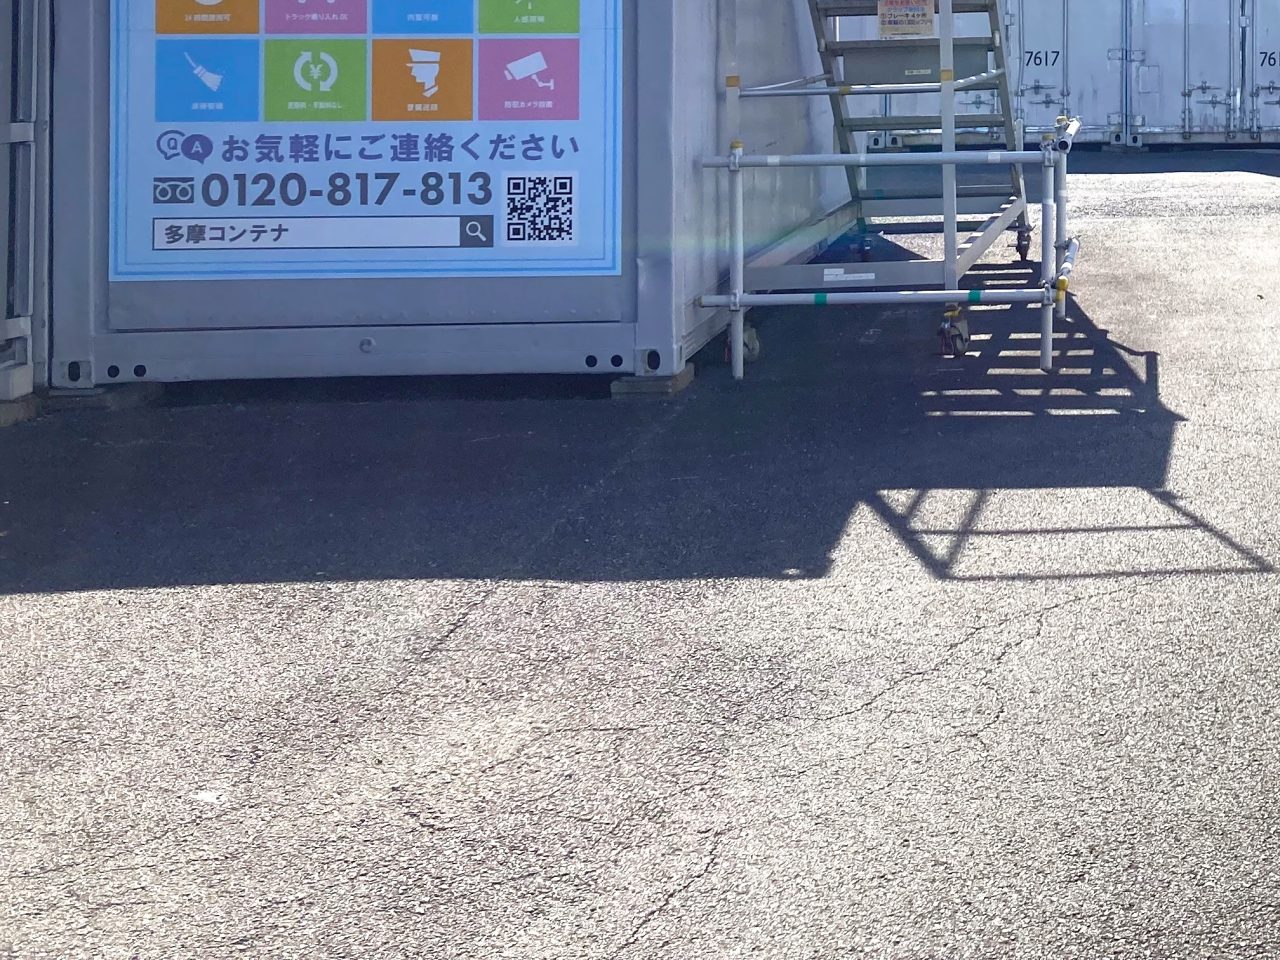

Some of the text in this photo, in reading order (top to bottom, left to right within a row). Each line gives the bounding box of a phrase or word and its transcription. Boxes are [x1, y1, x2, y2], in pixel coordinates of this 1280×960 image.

[1024, 51, 1060, 67] 7617
[220, 132, 580, 164] お気軽にご連絡ください
[201, 171, 493, 207] 0120-817-813
[164, 223, 289, 243] 多摩コンテナ
